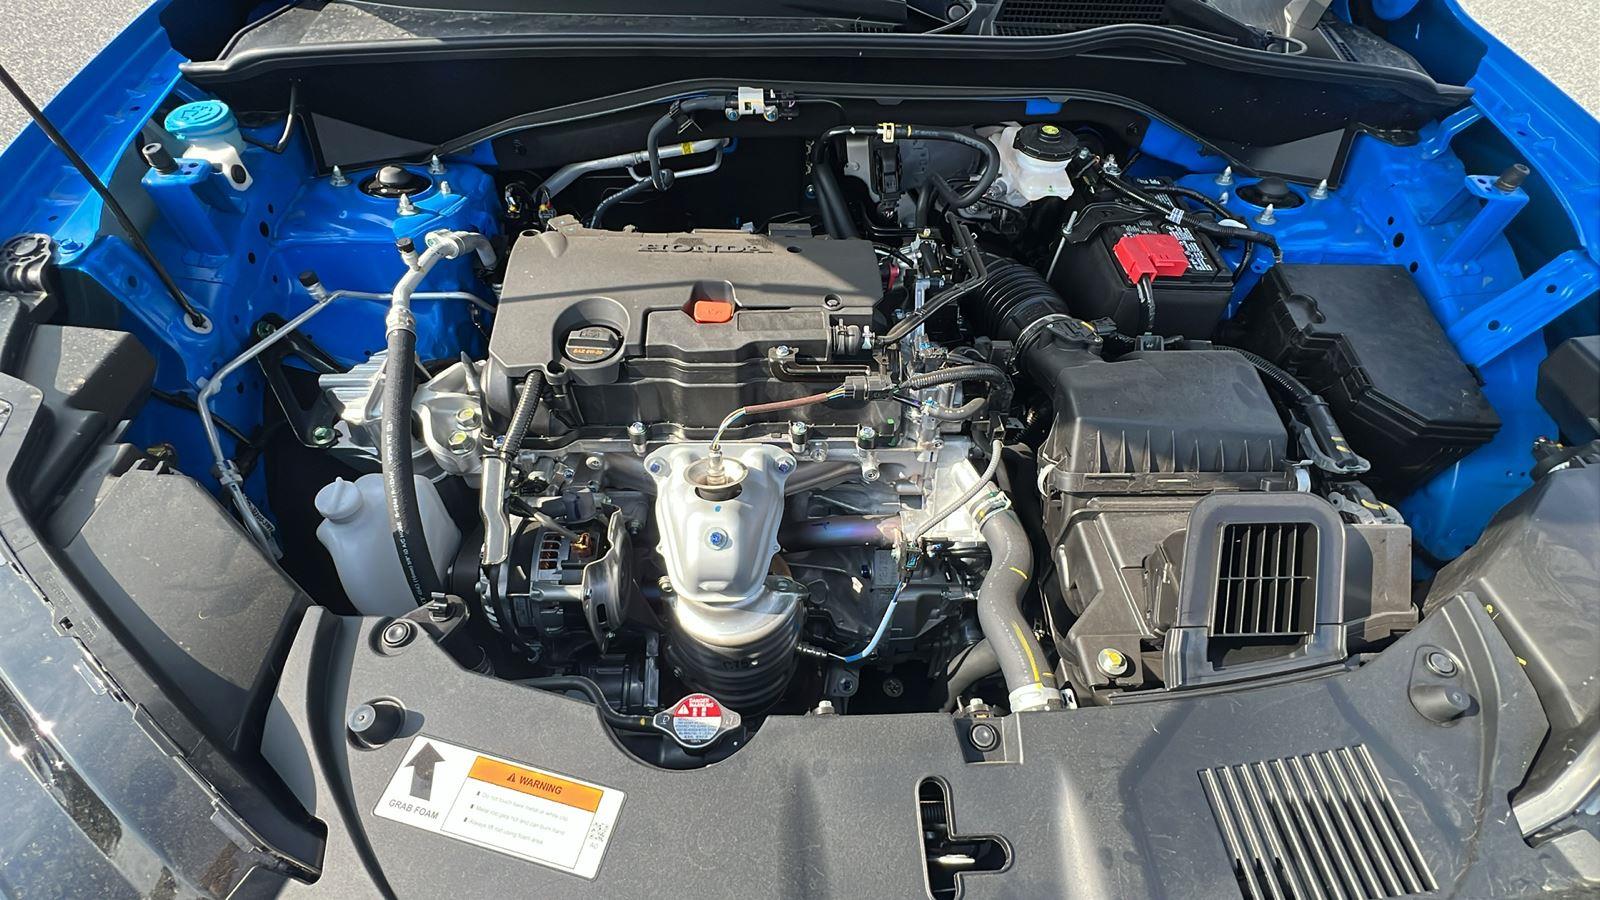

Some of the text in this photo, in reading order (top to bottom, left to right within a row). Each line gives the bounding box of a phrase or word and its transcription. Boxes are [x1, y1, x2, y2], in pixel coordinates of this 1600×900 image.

[638, 243, 773, 253] HONDA
[519, 776, 563, 795] WARNING
[389, 799, 439, 820] GRAB FOAM
